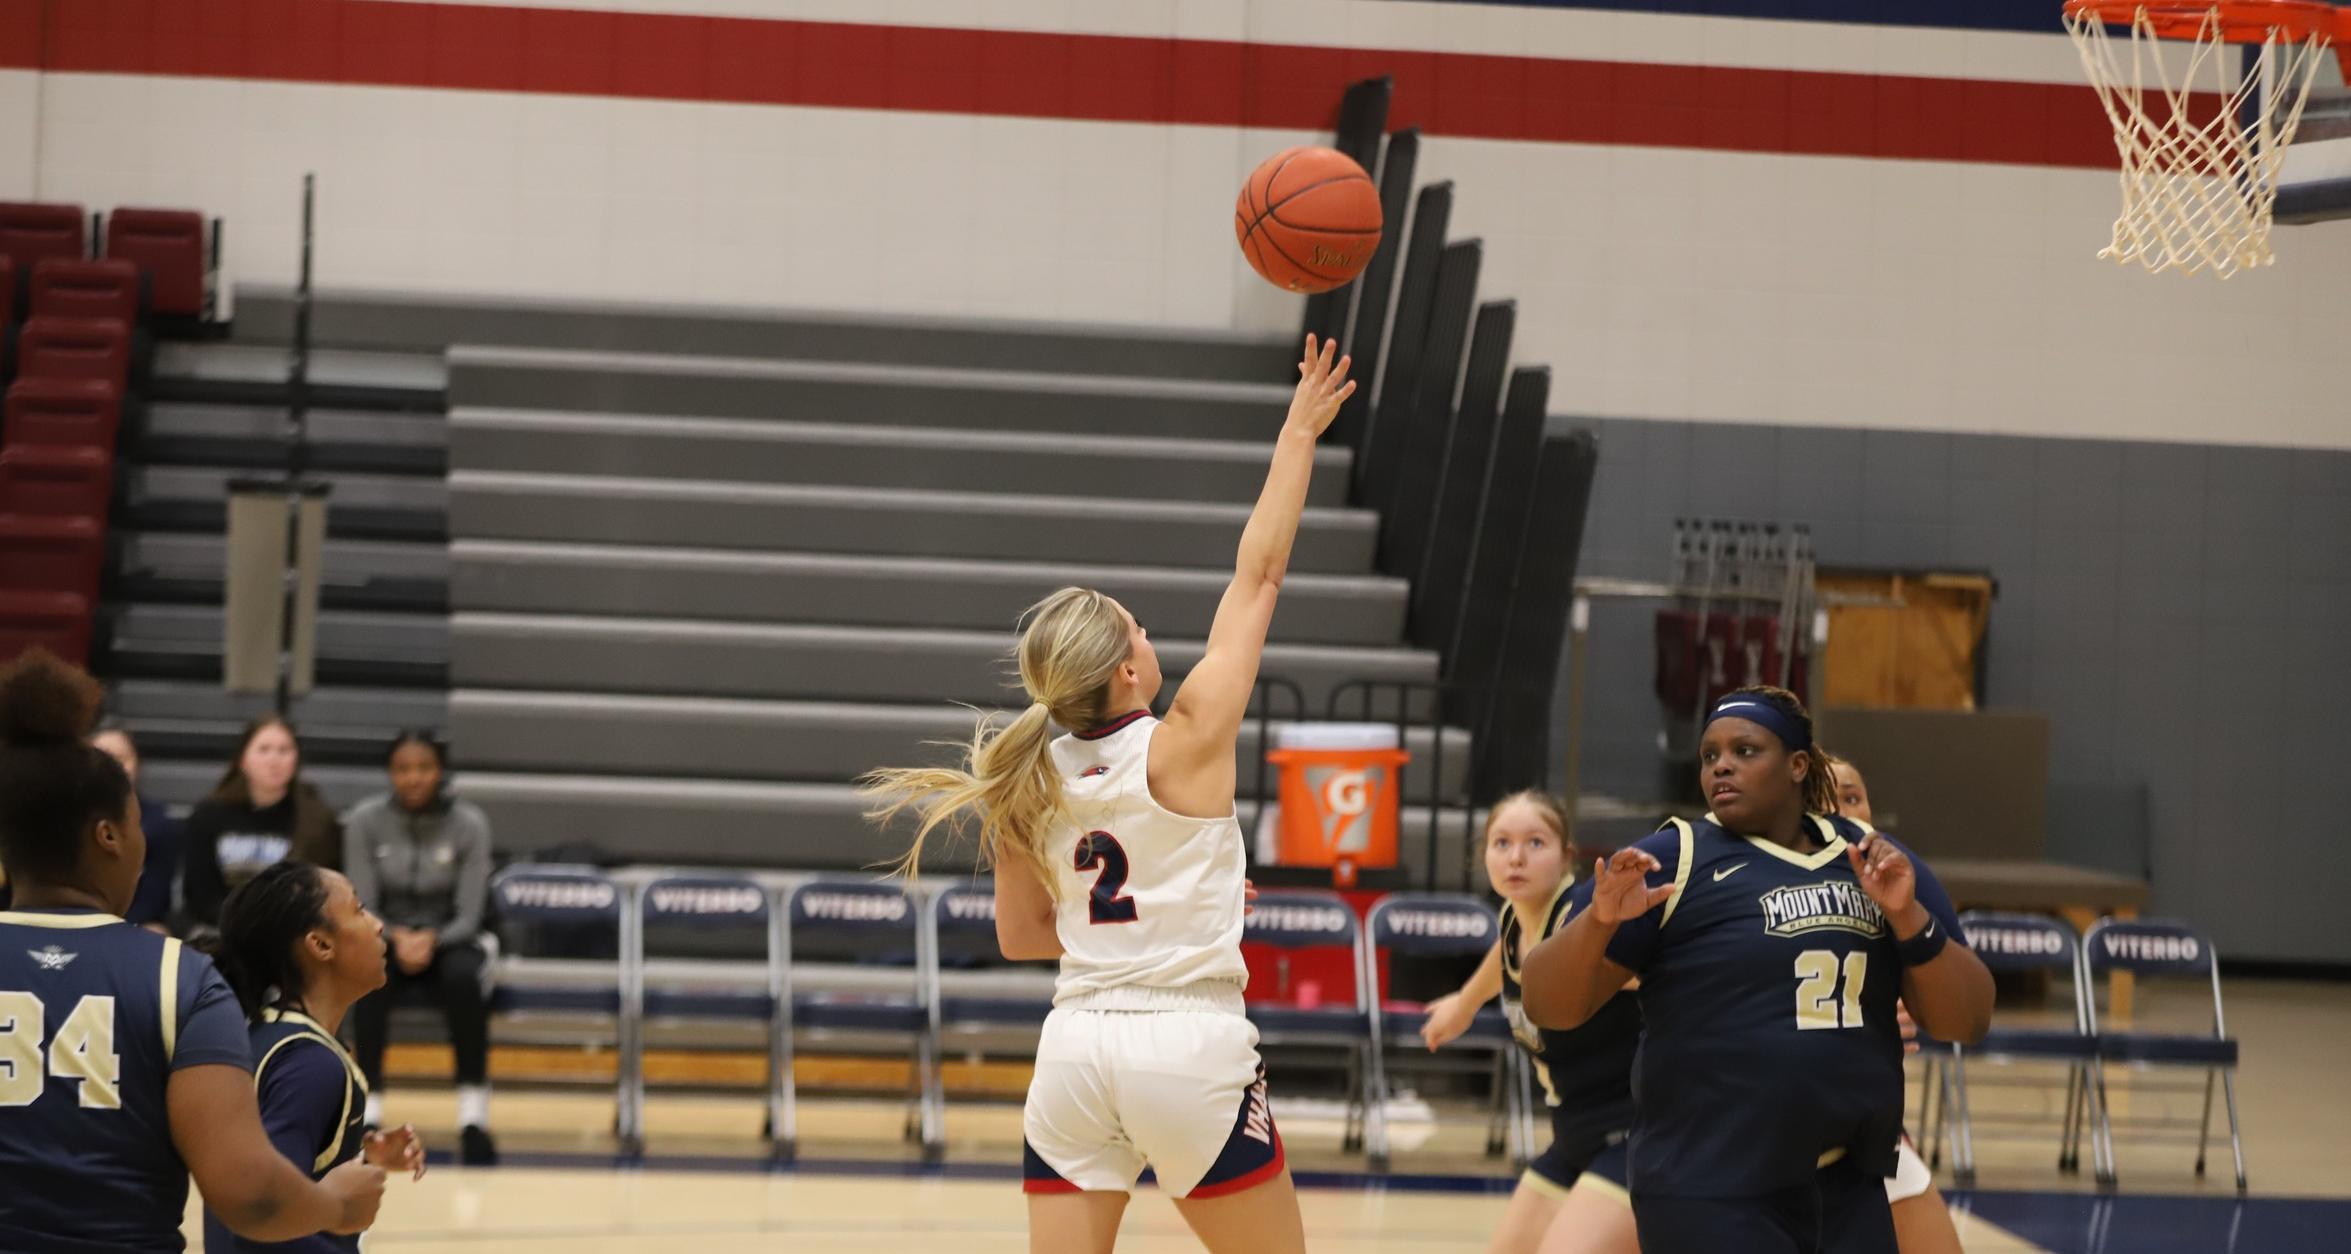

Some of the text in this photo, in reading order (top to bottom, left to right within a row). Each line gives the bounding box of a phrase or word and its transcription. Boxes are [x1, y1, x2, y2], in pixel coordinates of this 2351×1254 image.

[1327, 770, 1367, 816] G
[1073, 830, 1139, 925] 2
[801, 893, 907, 921] VITERBO
[1387, 910, 1489, 938] VITERBO
[1765, 887, 1831, 928] MOUNT
[1789, 917, 1822, 930] BLUE
[1964, 928, 2063, 954] VITERBO
[2103, 933, 2199, 960] VITERBO
[1794, 950, 1867, 1031] 21
[0, 991, 122, 1110] 34
